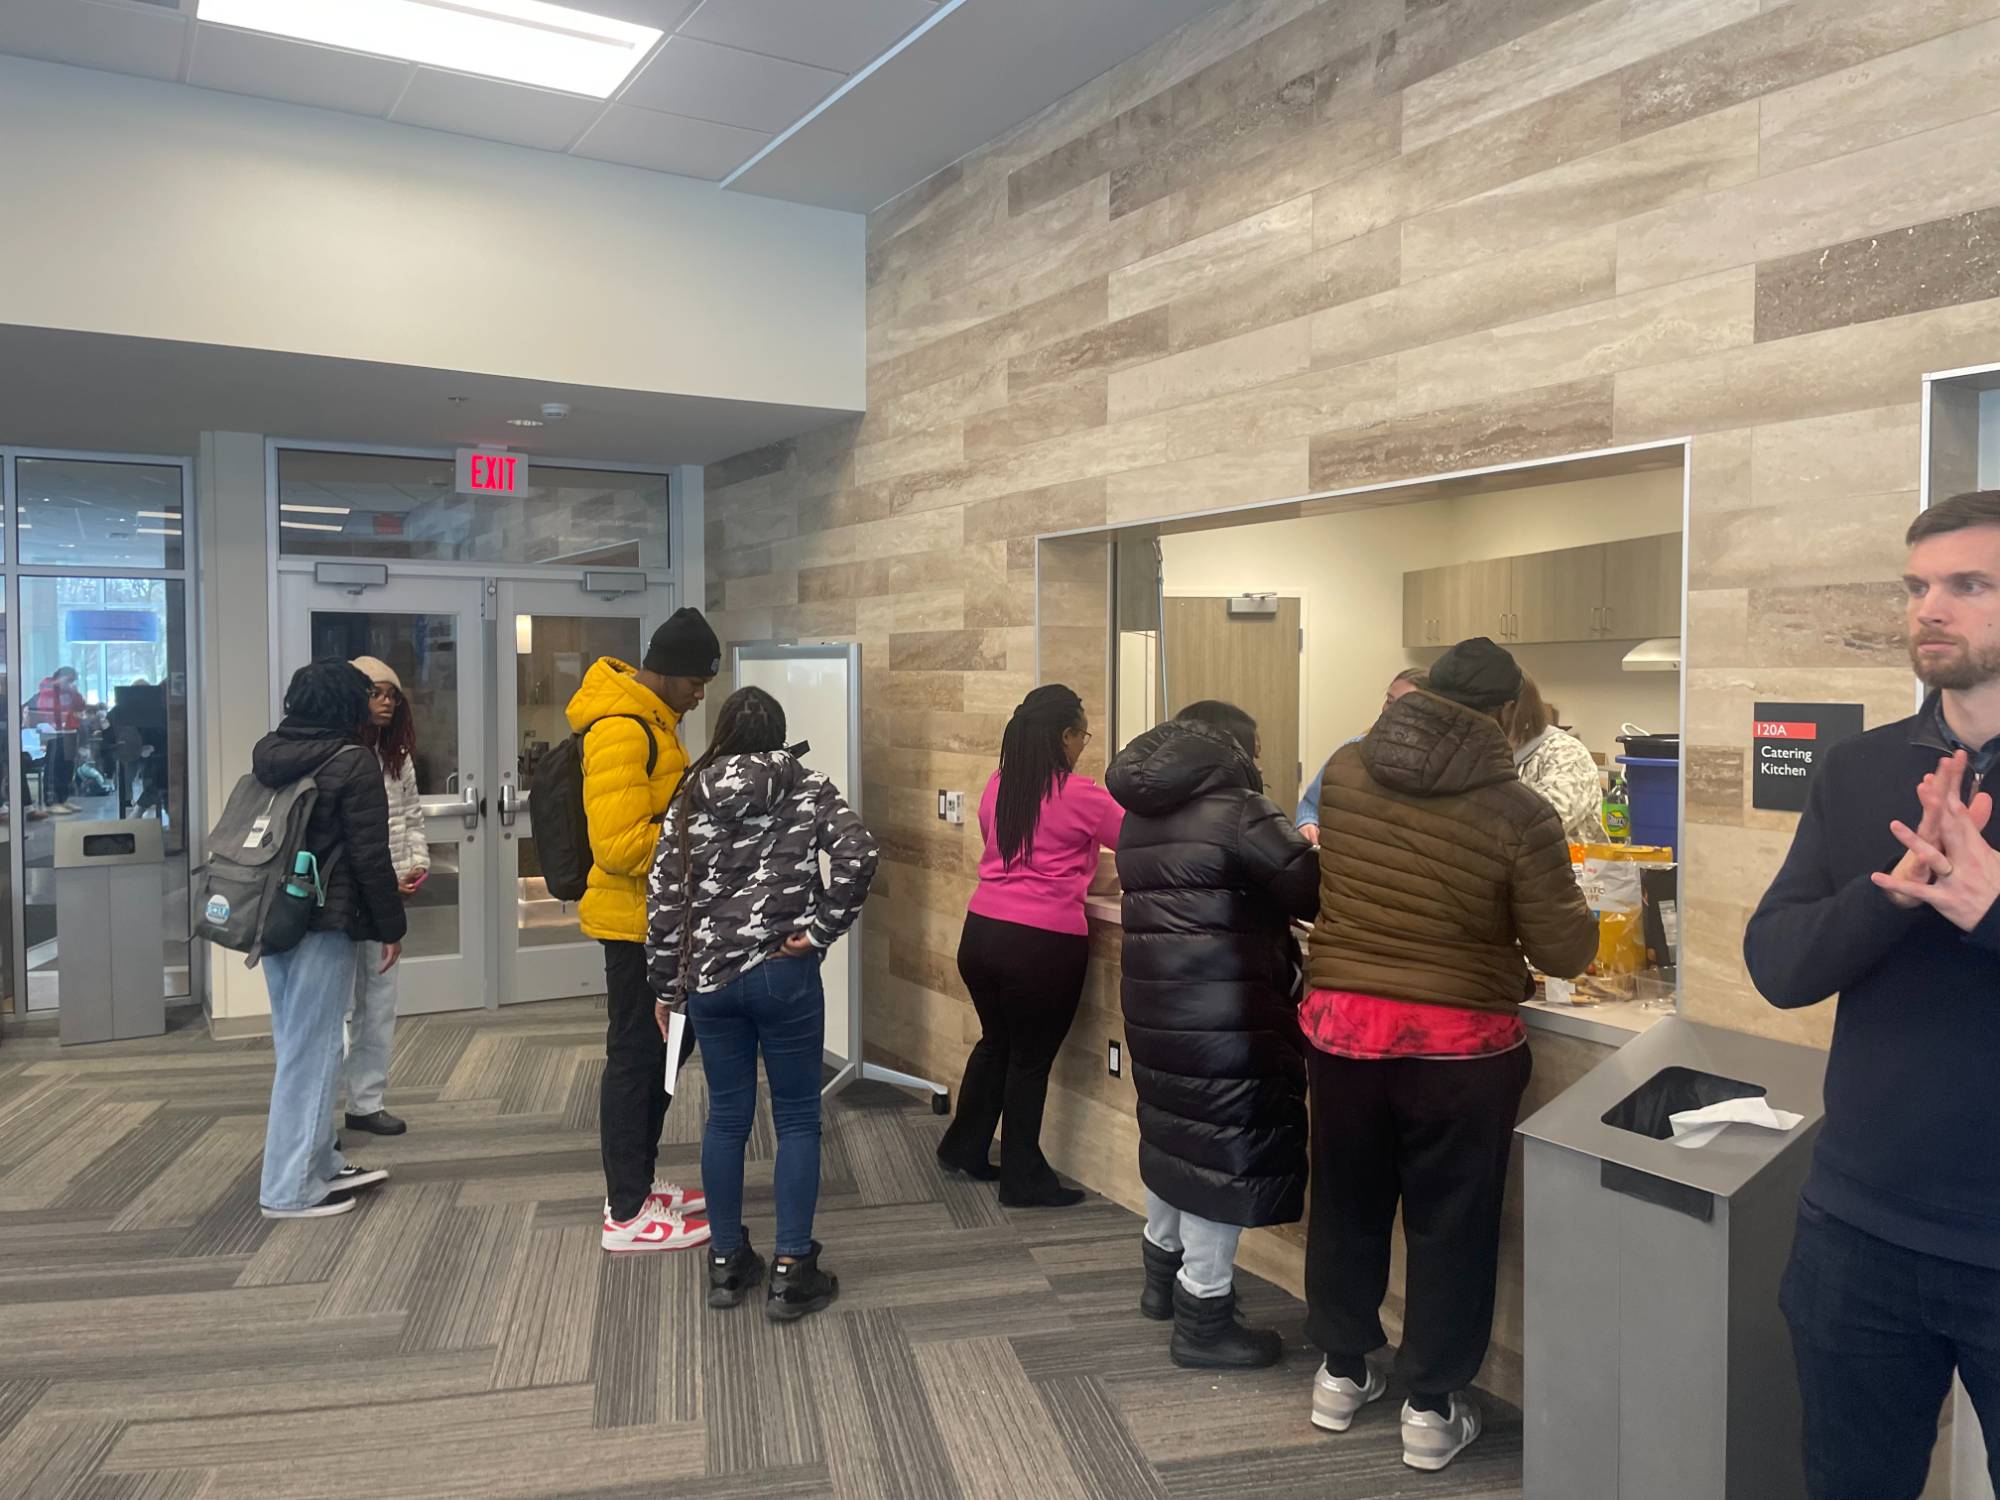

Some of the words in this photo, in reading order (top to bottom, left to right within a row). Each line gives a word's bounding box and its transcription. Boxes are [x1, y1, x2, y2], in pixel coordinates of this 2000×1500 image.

[471, 454, 518, 492] EXIT
[1756, 723, 1787, 737] 120A
[1760, 745, 1813, 763] Catering
[1760, 762, 1807, 777] Kitchen
